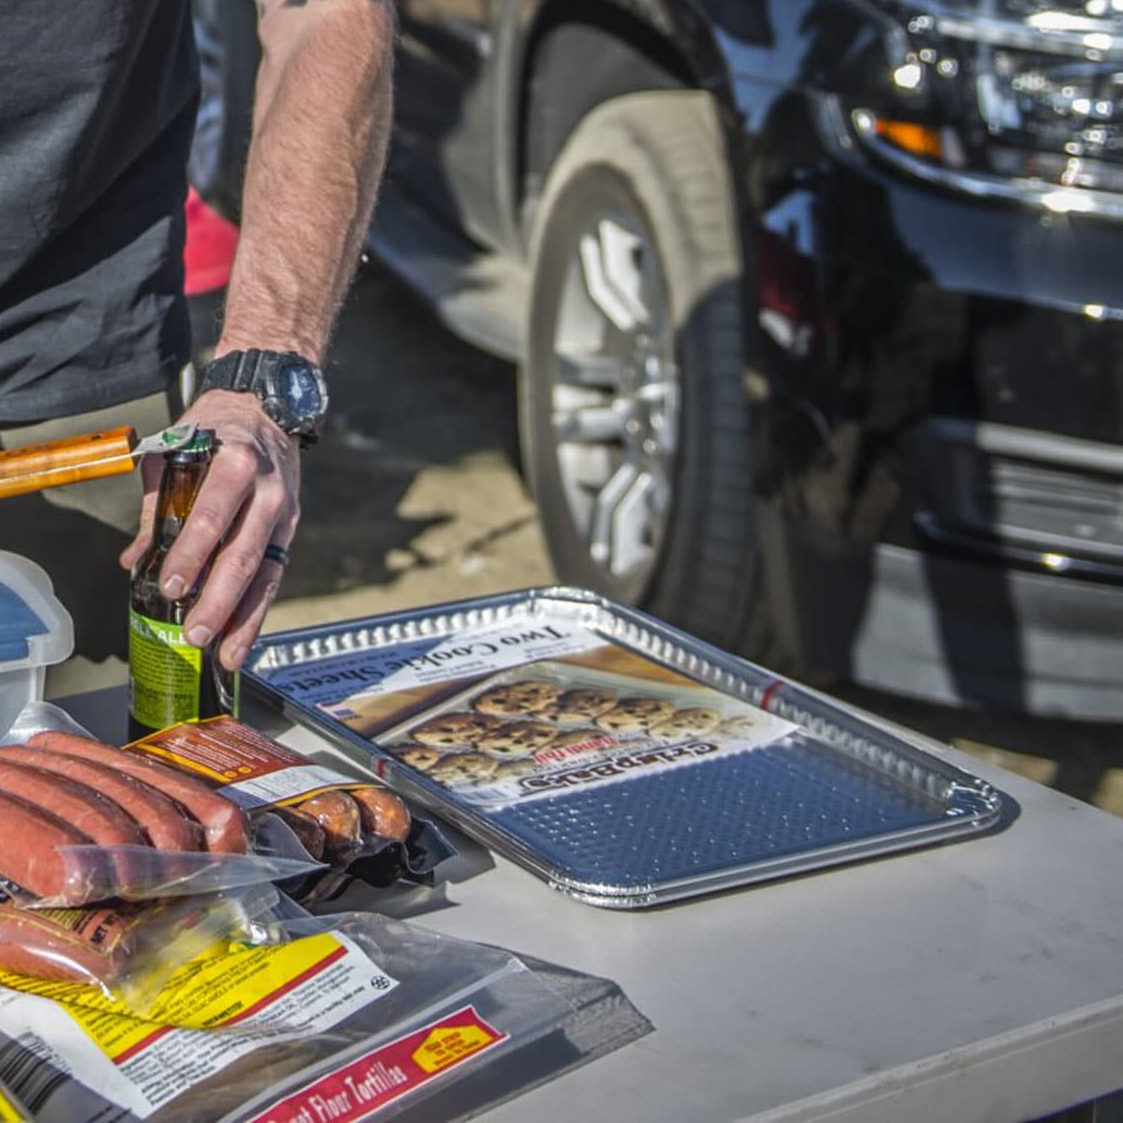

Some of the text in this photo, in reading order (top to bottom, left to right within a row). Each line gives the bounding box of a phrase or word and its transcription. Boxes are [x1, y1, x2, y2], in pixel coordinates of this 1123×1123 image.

[499, 624, 574, 647] Two
[389, 639, 500, 674] Cookie
[279, 665, 385, 695] Sheets
[307, 1087, 354, 1123] Flour
[344, 1061, 409, 1105] Tortillas
